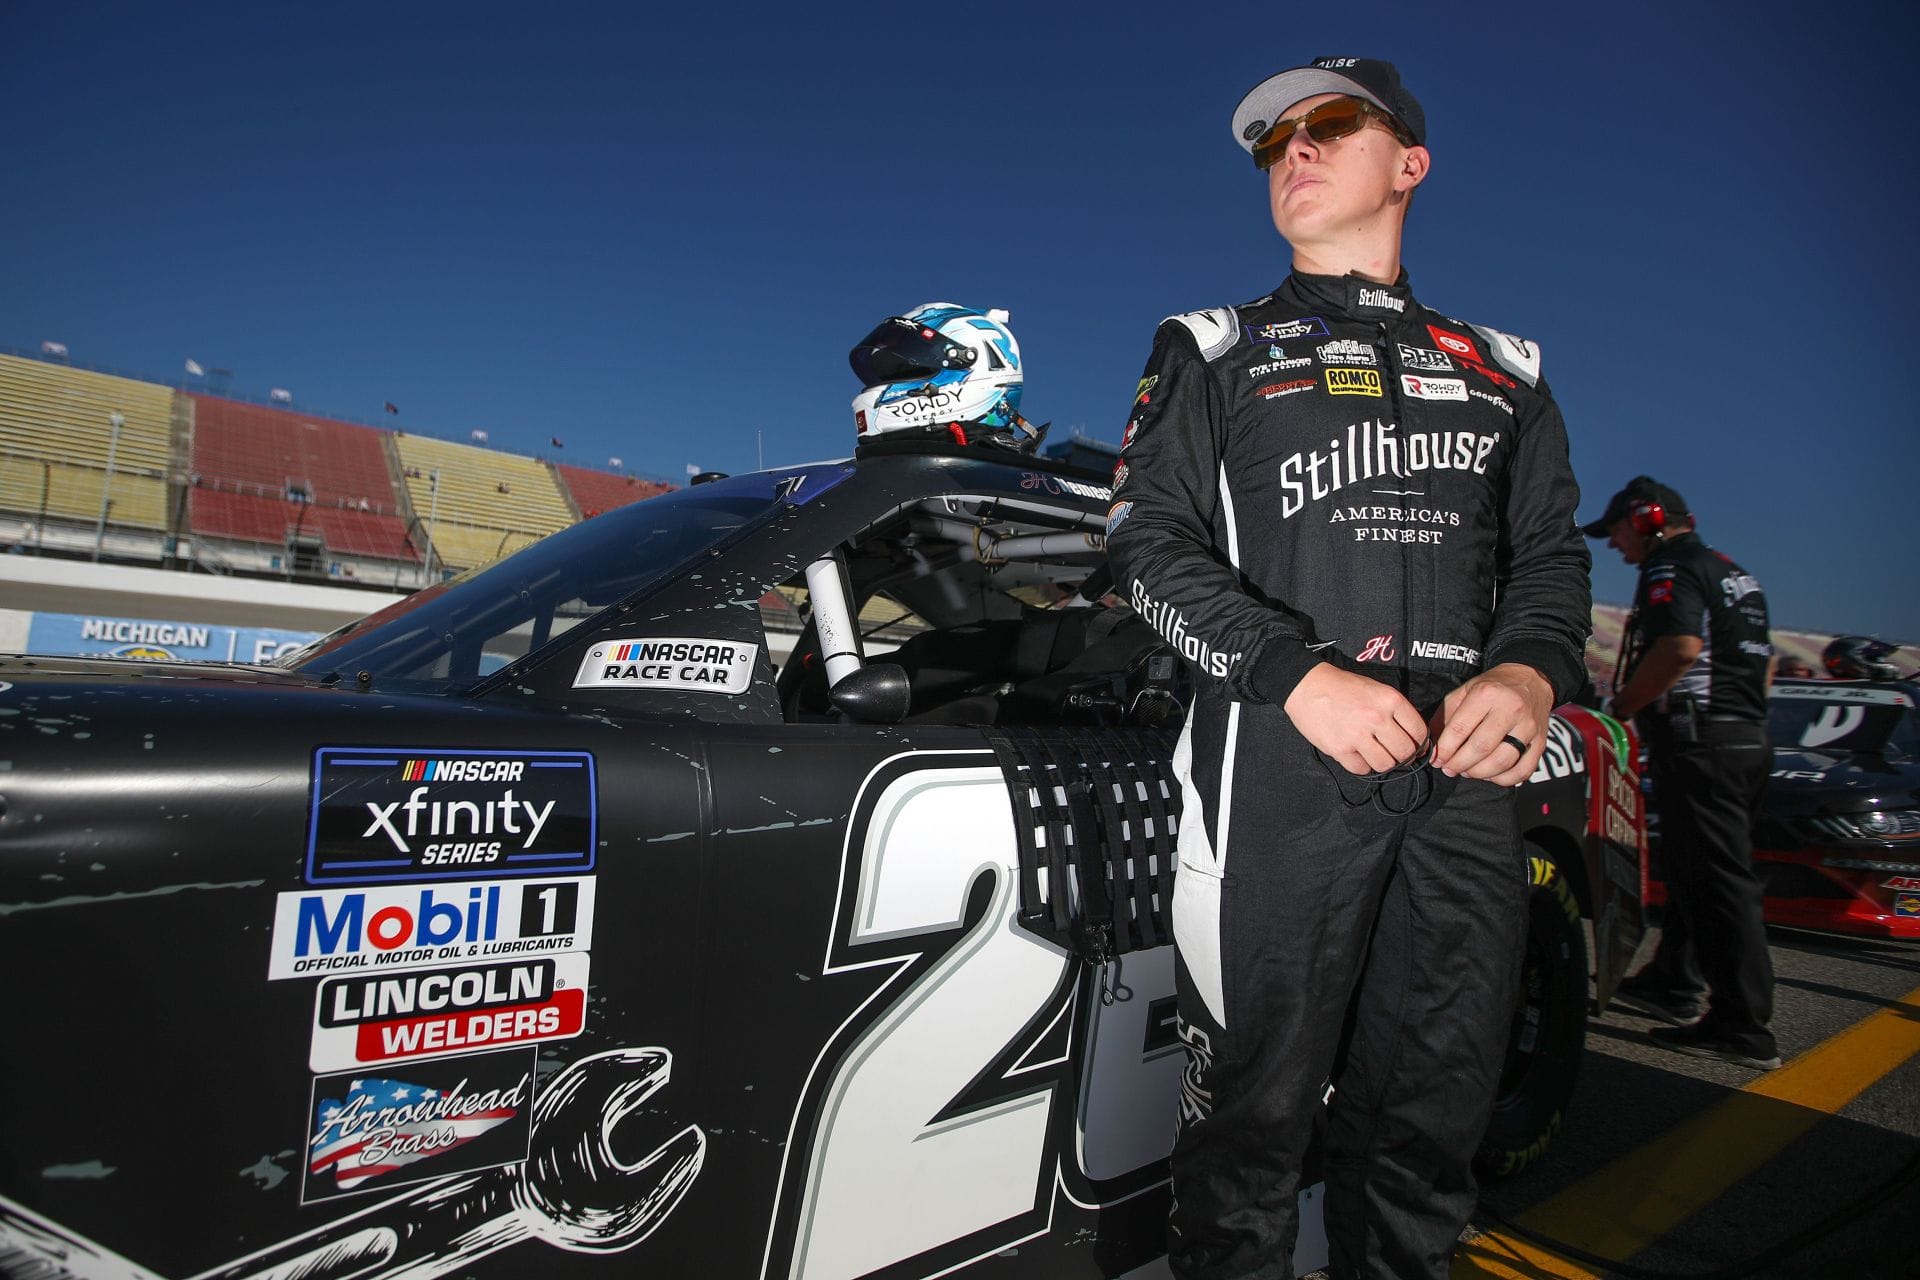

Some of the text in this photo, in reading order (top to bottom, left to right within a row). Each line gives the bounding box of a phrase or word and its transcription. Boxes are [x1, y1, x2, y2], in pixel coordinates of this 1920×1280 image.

[1328, 370, 1379, 388] ROMCO
[1423, 383, 1462, 392] ROWDY
[886, 388, 964, 418] ROWDY
[1469, 389, 1514, 415] GOODYEAR
[1329, 505, 1460, 526] AMERICA'S
[1354, 527, 1443, 544] FINEST
[81, 618, 209, 648] MICHIGAN
[639, 644, 735, 665] NASCAR
[603, 665, 729, 684] RACE CAR
[432, 760, 525, 782] NASCAR
[362, 786, 556, 853] xfinity
[421, 842, 501, 865] SERIES
[293, 885, 558, 957] Mobil 1
[293, 936, 574, 972] OFFICIAL MOTOR OIL & LUBRICANTS
[332, 964, 545, 1022] LINCOLN
[381, 1006, 561, 1056] WELDERS
[310, 1073, 531, 1144] Arrowhead
[358, 1128, 458, 1166] Brass
